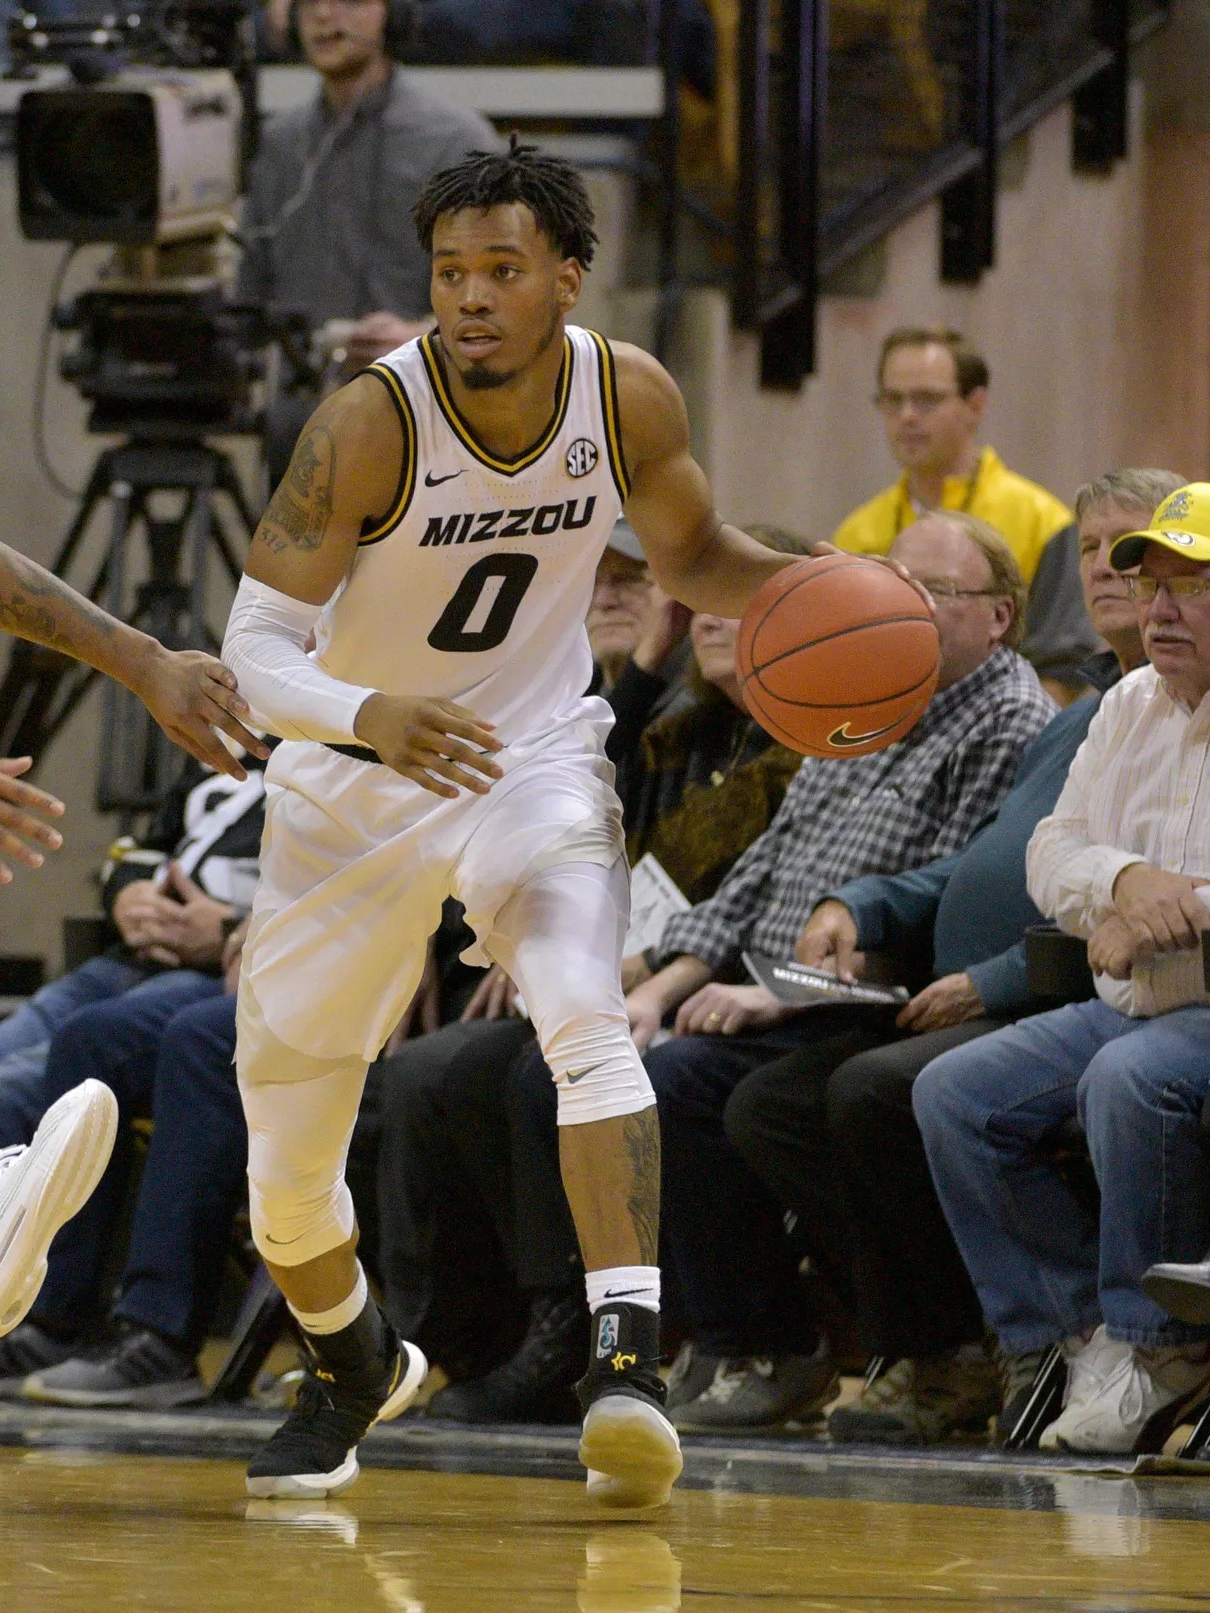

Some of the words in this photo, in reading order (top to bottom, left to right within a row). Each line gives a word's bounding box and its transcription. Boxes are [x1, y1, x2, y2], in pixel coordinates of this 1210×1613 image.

[566, 440, 598, 477] SEC
[418, 495, 597, 546] MIZZOU
[427, 553, 538, 652] 0
